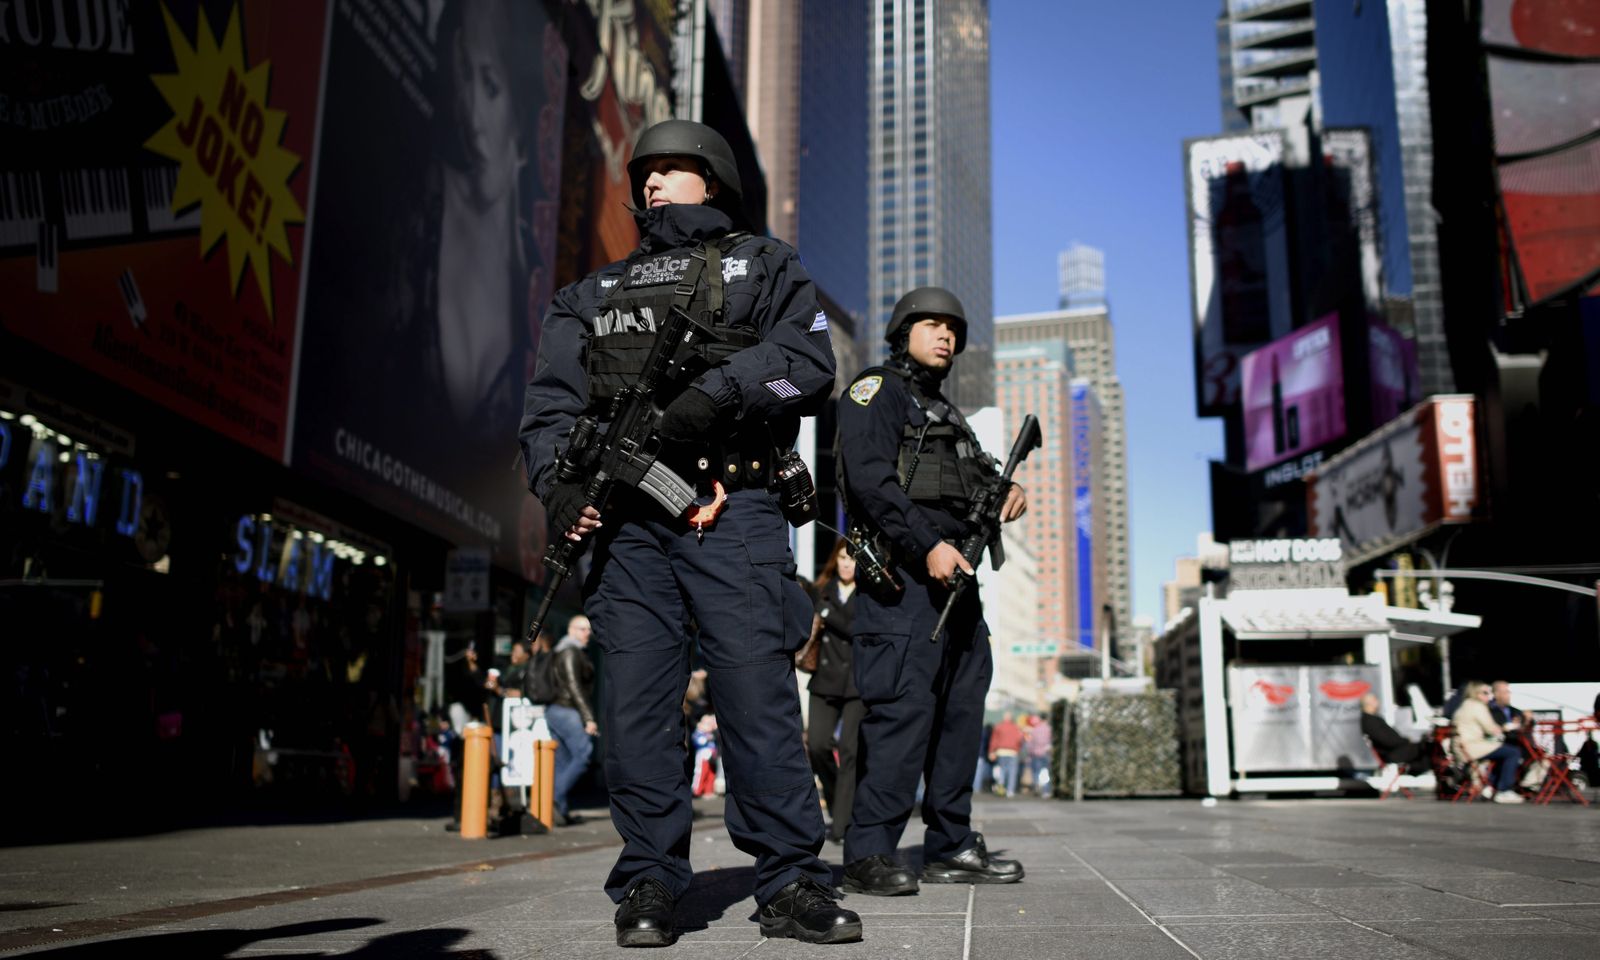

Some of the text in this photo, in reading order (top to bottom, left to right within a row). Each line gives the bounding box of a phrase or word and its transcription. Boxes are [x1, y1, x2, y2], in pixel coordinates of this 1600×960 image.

[27, 83, 113, 130] MURDER
[218, 66, 265, 160] NO
[176, 96, 273, 246] JOKE!
[630, 258, 691, 277] POLICE
[1265, 451, 1323, 486] INGLOT
[235, 514, 335, 600] SLAM
[1256, 538, 1291, 562] HOT
[1292, 538, 1342, 561] DOGS
